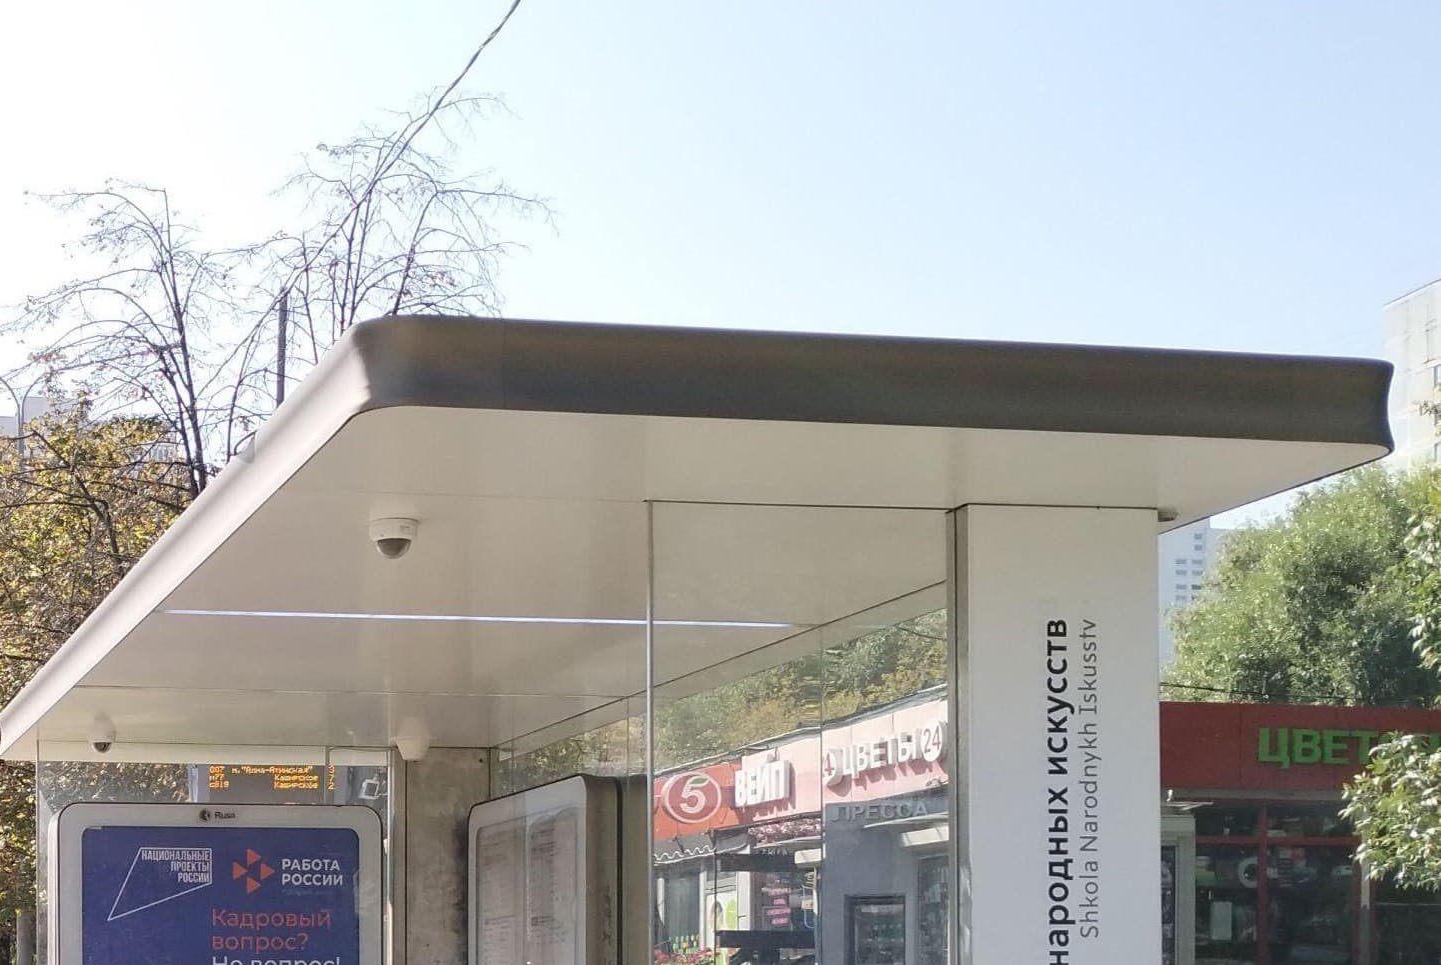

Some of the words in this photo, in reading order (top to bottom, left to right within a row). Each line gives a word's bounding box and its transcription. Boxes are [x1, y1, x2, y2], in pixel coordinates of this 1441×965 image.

[1077, 618, 1099, 716] Iskusstv
[1046, 618, 1075, 776] искусств
[841, 727, 922, 780] ЦВЕТЫ
[923, 725, 942, 756] 24
[1259, 727, 1441, 769] ЦВЕТ
[734, 745, 792, 808] ВЕЙП
[1077, 722, 1102, 853] Narodnykh
[679, 776, 709, 814] 5
[830, 800, 928, 822] ПРЕССА
[141, 850, 210, 862] НАЦИОНАЛЬНЫЕ
[170, 861, 210, 872] ПРОЕКТЫ
[281, 858, 341, 872] РАБОТА
[177, 872, 210, 883] РОССИИ
[281, 873, 343, 886] РОССИИ
[1078, 859, 1100, 939] Shkola
[212, 908, 331, 931] Кадровый
[212, 932, 309, 955] вопрос?
